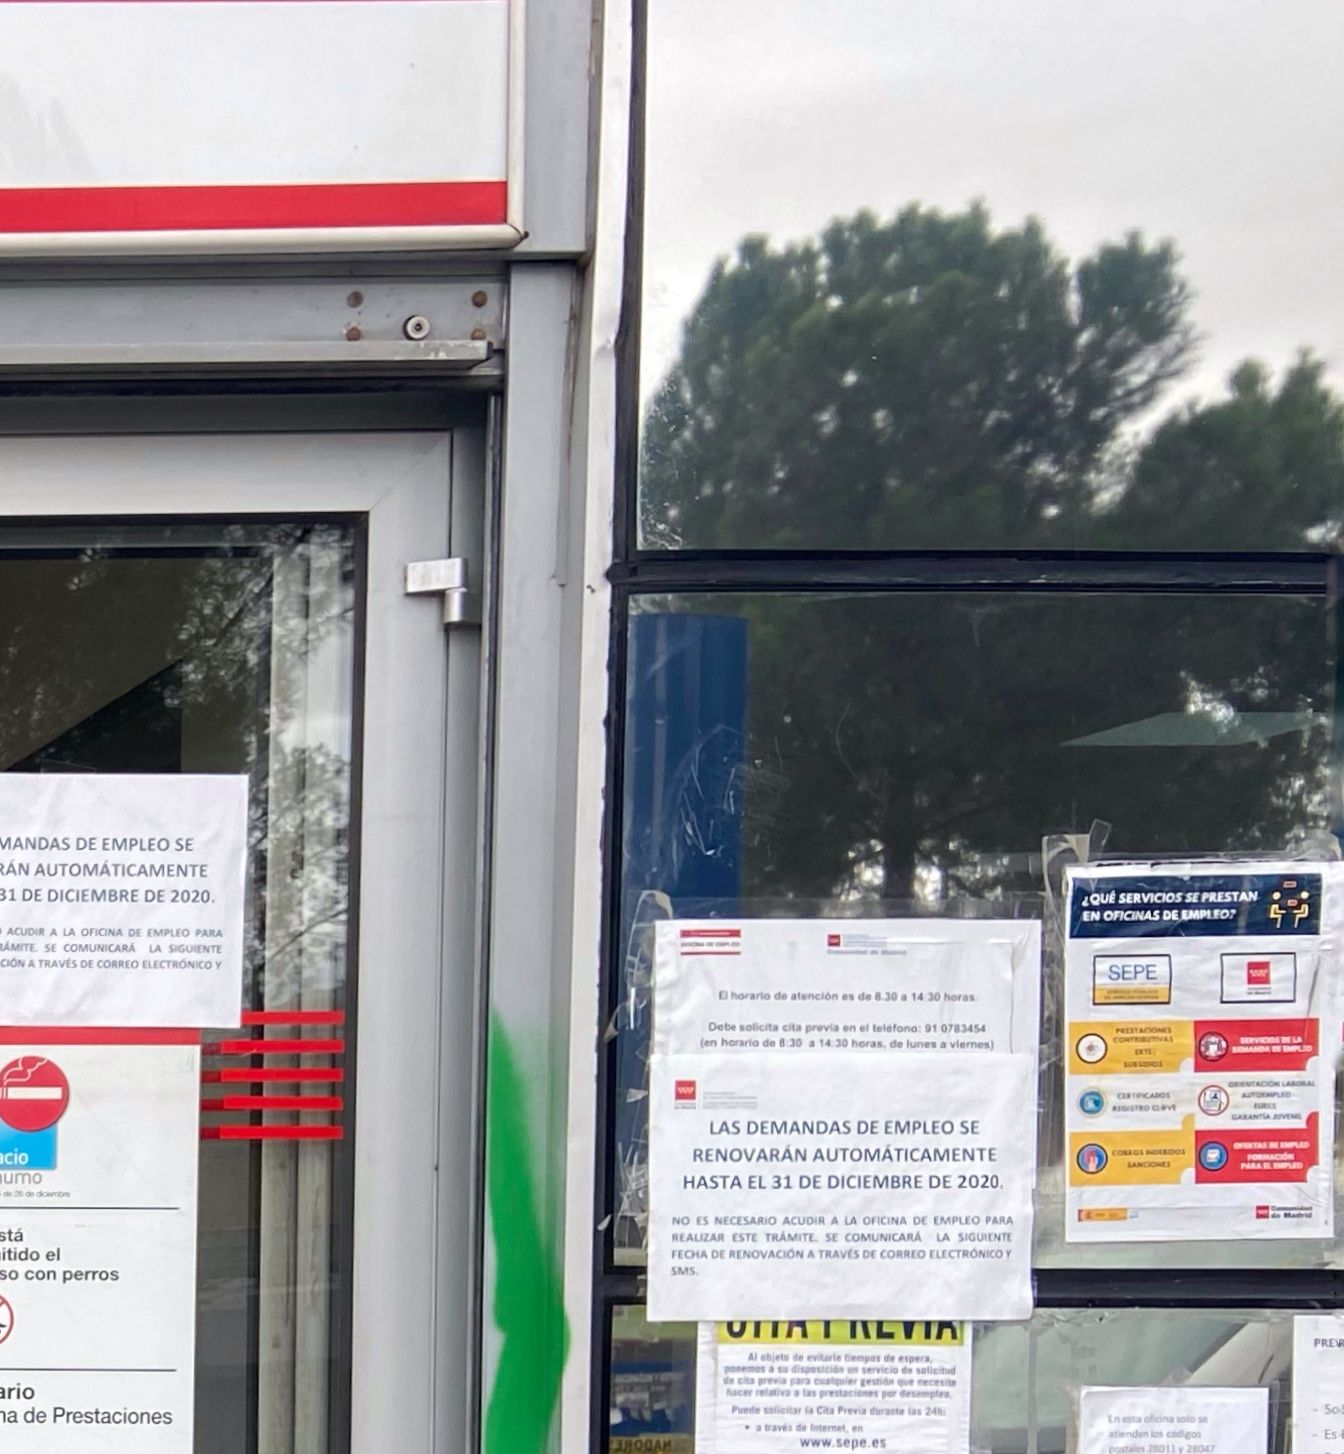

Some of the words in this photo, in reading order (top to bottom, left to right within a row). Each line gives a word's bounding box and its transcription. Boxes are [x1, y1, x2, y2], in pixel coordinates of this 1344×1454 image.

[75, 837, 97, 850] DE
[102, 837, 170, 851] EMPLEO
[174, 837, 194, 851] SE
[34, 859, 208, 878] AUTOMÁTICAMENTE
[22, 888, 42, 902] DE
[47, 888, 138, 903] DICIEMBRE
[144, 889, 165, 903] DE
[170, 889, 215, 904] 2020.
[1081, 889, 1116, 907] ¿QUÉ
[1118, 892, 1182, 904] SERVICIOS
[1185, 892, 1200, 903] SE
[1201, 891, 1258, 903] PRESTAN
[1083, 911, 1100, 921] EN
[1104, 910, 1159, 922] OFICINAS
[1163, 909, 1179, 921] DE
[1181, 909, 1235, 920] EMPLEO?
[1108, 965, 1158, 981] SEPE
[718, 990, 728, 1000] El
[730, 990, 771, 1000] horario
[773, 990, 787, 1000] de
[790, 990, 838, 1001] atención
[841, 993, 854, 1001] es
[857, 991, 871, 1001] de
[900, 993, 907, 1001] a
[708, 1022, 736, 1031] Debe
[739, 1022, 778, 1031] solicita
[782, 1023, 801, 1031] cita
[805, 1023, 839, 1033] previa
[859, 1023, 869, 1032] el
[872, 1023, 920, 1033] teléfono:
[925, 1023, 936, 1033] 91
[699, 1037, 717, 1049] (en
[720, 1037, 759, 1047] horario
[762, 1037, 775, 1047] de
[889, 1039, 903, 1048] de
[906, 1038, 936, 1049] lunes
[948, 1039, 994, 1051] viernes)
[709, 1120, 740, 1135] LAS
[746, 1120, 851, 1135] DEMANDAS
[857, 1120, 879, 1135] DE
[884, 1120, 954, 1135] EMPLEO
[959, 1120, 979, 1135] SE
[693, 1144, 807, 1162] RENOVARÁN
[812, 1144, 996, 1162] AUTOMÁTICAMENTE
[683, 1175, 742, 1189] HASTA
[748, 1175, 766, 1189] EL
[771, 1174, 792, 1189] 31
[799, 1174, 821, 1189] DE
[827, 1174, 923, 1189] DICIEMBRE
[928, 1174, 952, 1189] DE
[957, 1174, 1003, 1189] 2020.
[45, 1247, 60, 1261] el
[24, 1269, 56, 1280] con
[62, 1269, 119, 1284] perros
[23, 1406, 47, 1423] de
[53, 1406, 172, 1424] Prestaciones
[799, 1437, 886, 1450] www.sepe.es
